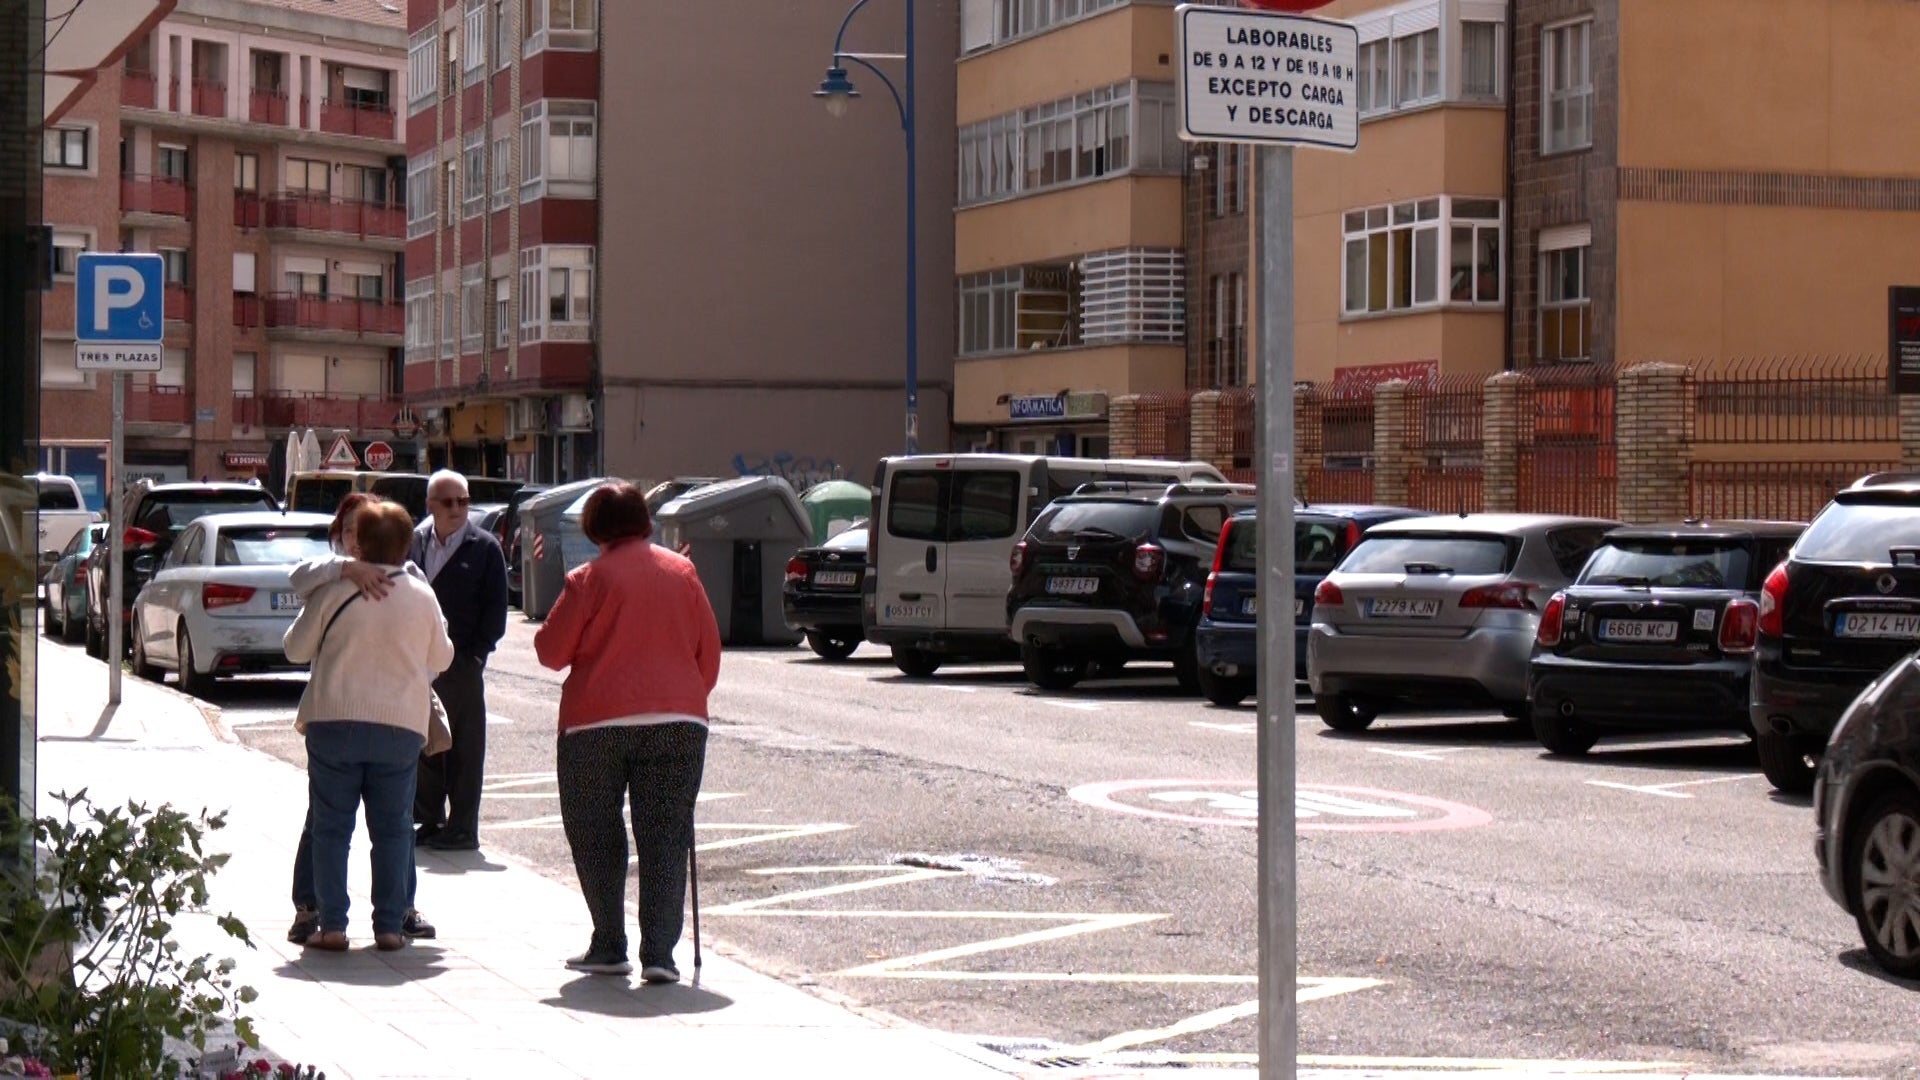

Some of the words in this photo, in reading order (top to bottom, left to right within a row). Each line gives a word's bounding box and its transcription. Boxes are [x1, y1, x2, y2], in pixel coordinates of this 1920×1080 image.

[1226, 26, 1333, 53] LABORABLES
[1193, 51, 1213, 67] DE
[1218, 53, 1228, 68] 9
[1234, 54, 1245, 70] A
[1251, 55, 1266, 71] 12
[1271, 57, 1281, 72] Y
[1286, 58, 1304, 74] DE
[1308, 60, 1319, 76] 15
[1322, 63, 1330, 78] A
[1332, 65, 1342, 80] 18
[1346, 66, 1353, 82] H
[1208, 76, 1292, 99] EXCEPTO
[1301, 83, 1344, 106] CARGA
[1226, 105, 1238, 122] Y
[1249, 106, 1334, 130] DESCARGA
[94, 265, 145, 331] P
[80, 351, 110, 363] TRES
[115, 353, 159, 363] PLAZAS
[1011, 398, 1063, 414] NFORMATICA
[367, 452, 391, 464] STOP
[1375, 599, 1407, 613] 2279
[1409, 600, 1436, 614] KJN
[1608, 622, 1643, 636] 6606
[1647, 623, 1674, 638] MCJ
[1847, 615, 1889, 632] 0214
[1895, 616, 1920, 633] HV
